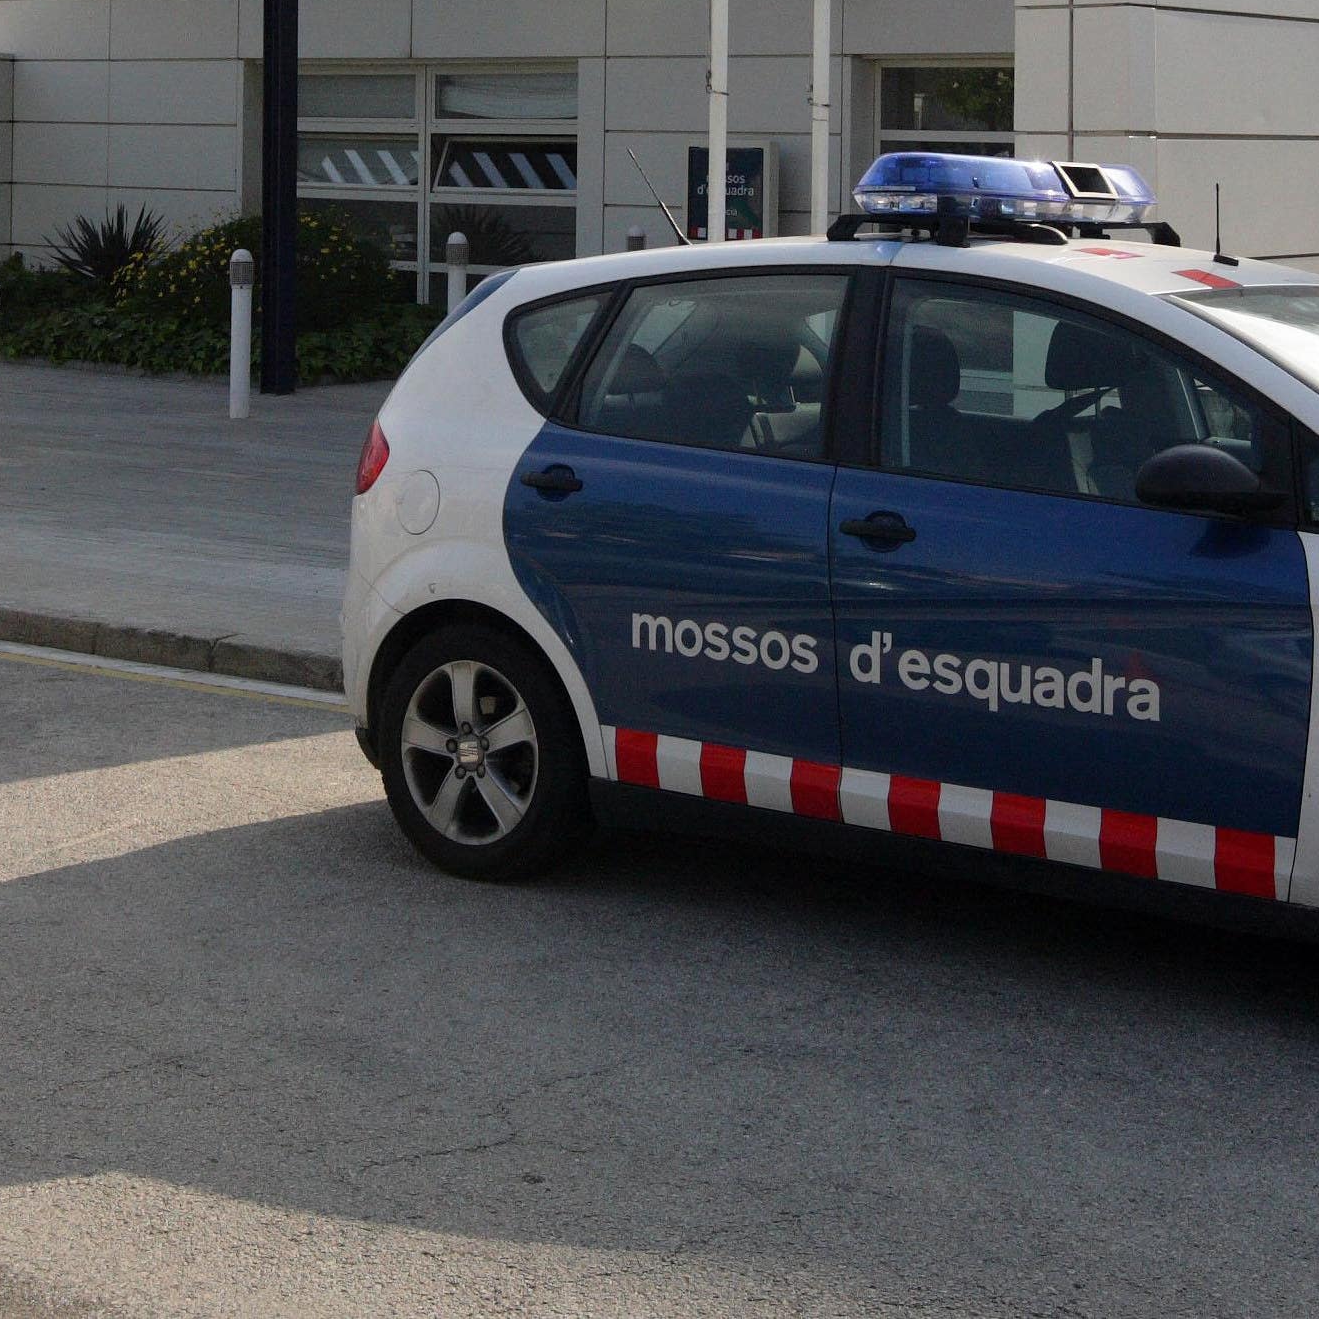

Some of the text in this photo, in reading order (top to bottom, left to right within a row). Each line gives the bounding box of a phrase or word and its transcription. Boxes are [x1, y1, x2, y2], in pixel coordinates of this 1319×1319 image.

[696, 184, 755, 197] d'uadra
[631, 612, 1161, 723] mossos d'esquadra
